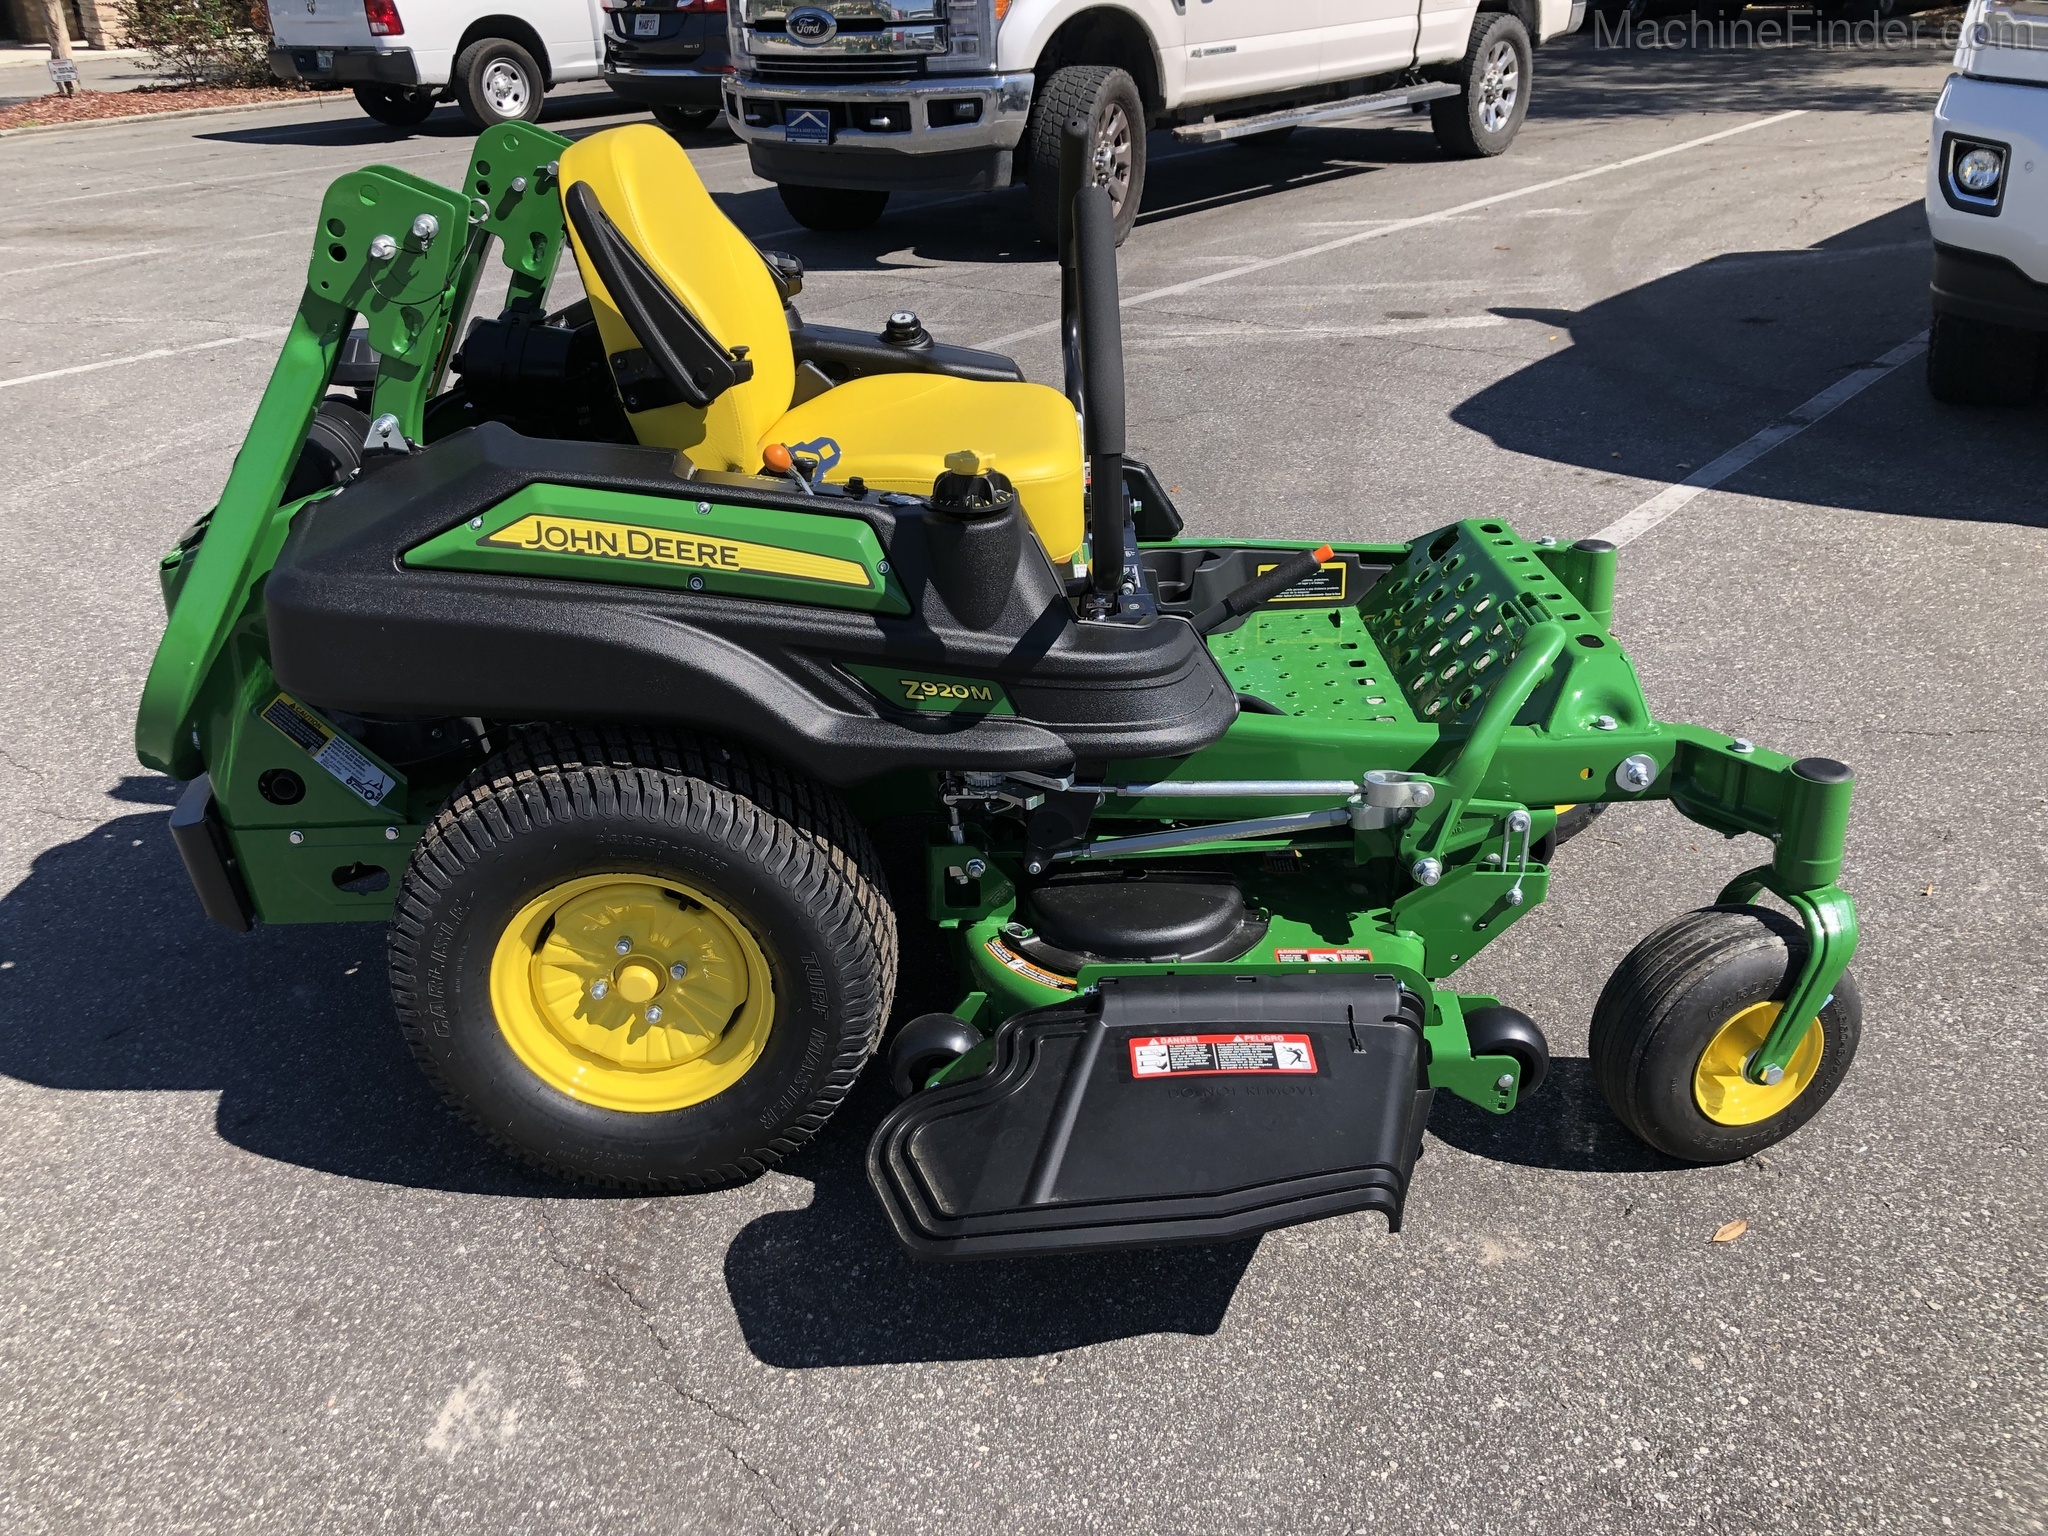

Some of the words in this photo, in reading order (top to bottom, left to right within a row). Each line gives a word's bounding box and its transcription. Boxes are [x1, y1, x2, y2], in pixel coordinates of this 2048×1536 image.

[796, 17, 821, 35] Ford
[525, 520, 618, 553] JOHN
[626, 529, 740, 568] DEERE
[900, 680, 993, 702] Z920M
[295, 706, 323, 730] CAUTION
[800, 951, 829, 1021] TURF
[1159, 1035, 1199, 1045] DANGER
[1243, 1034, 1285, 1043] PELIGRO
